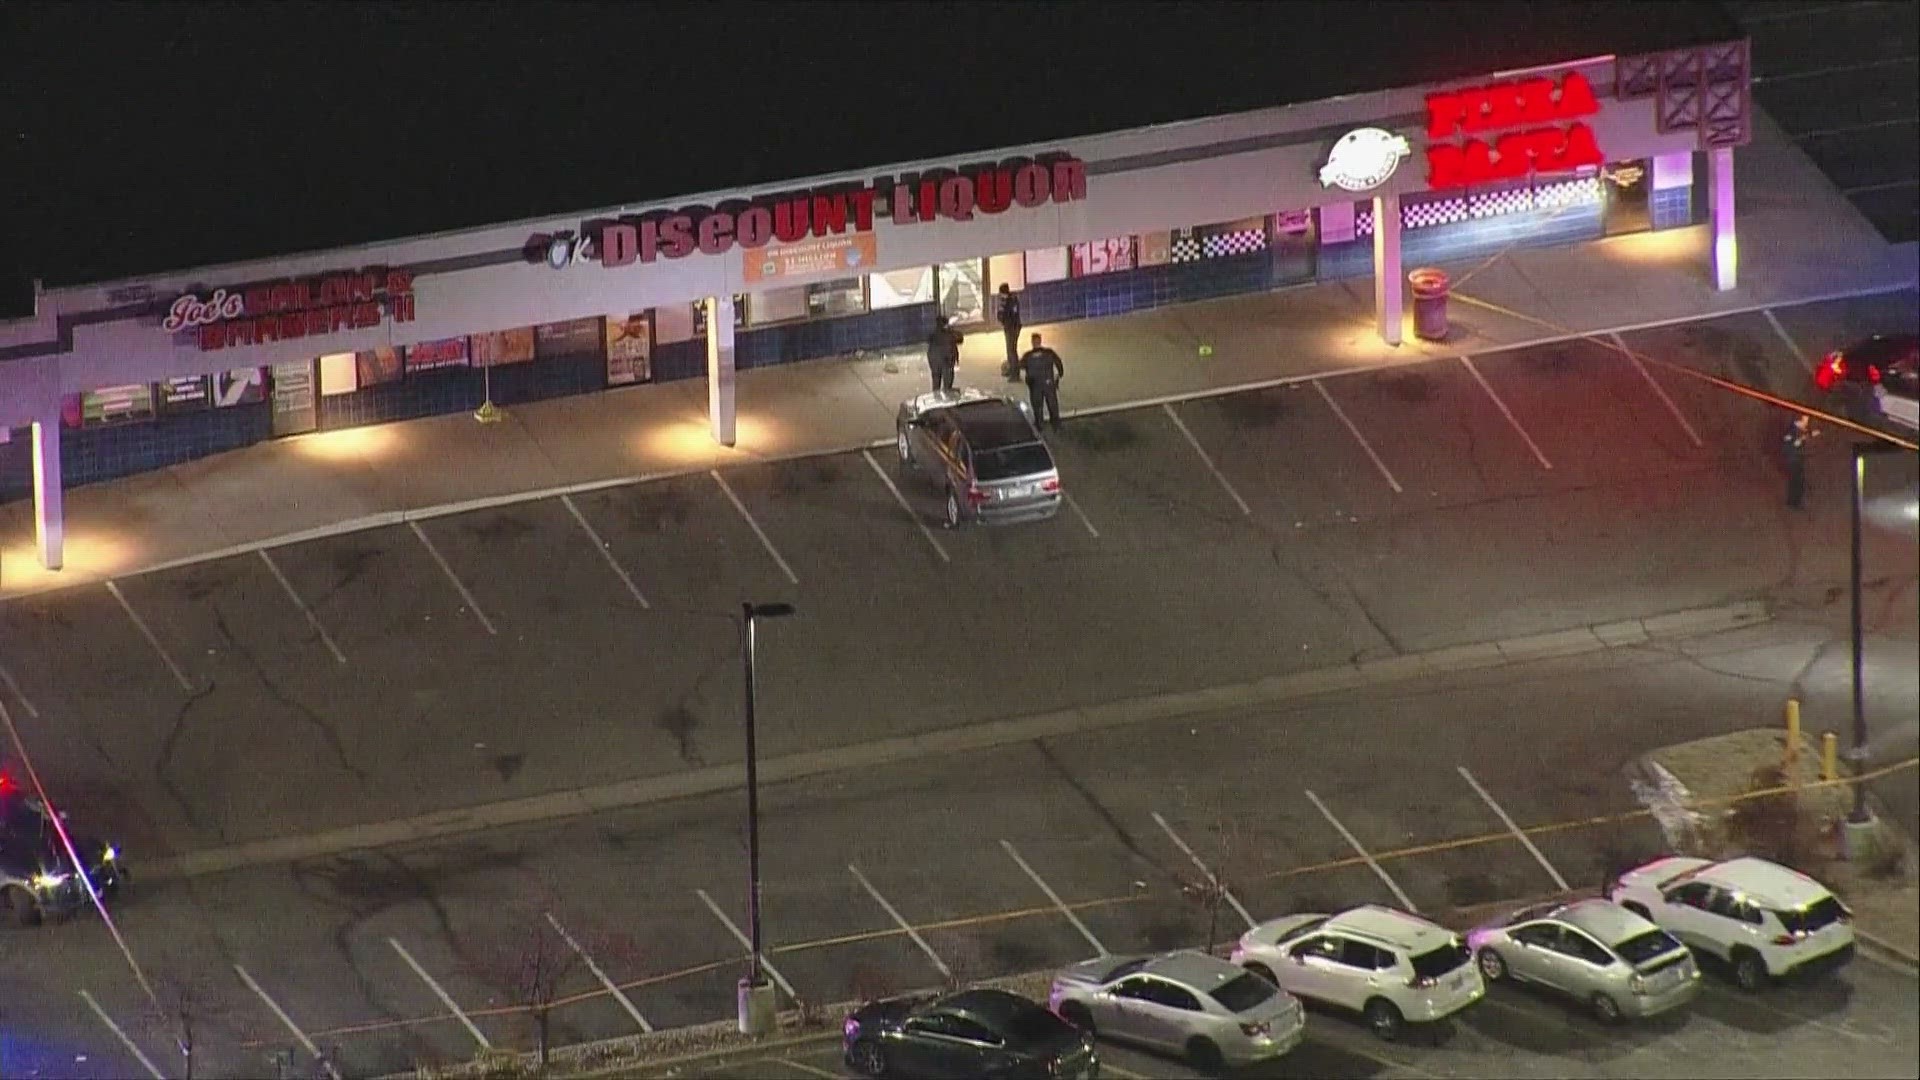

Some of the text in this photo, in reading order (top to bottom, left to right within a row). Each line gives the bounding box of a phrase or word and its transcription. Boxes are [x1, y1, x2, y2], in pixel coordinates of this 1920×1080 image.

[549, 158, 1087, 270] OK DISCOUNT LIQUOR
[163, 288, 245, 333] Joe's
